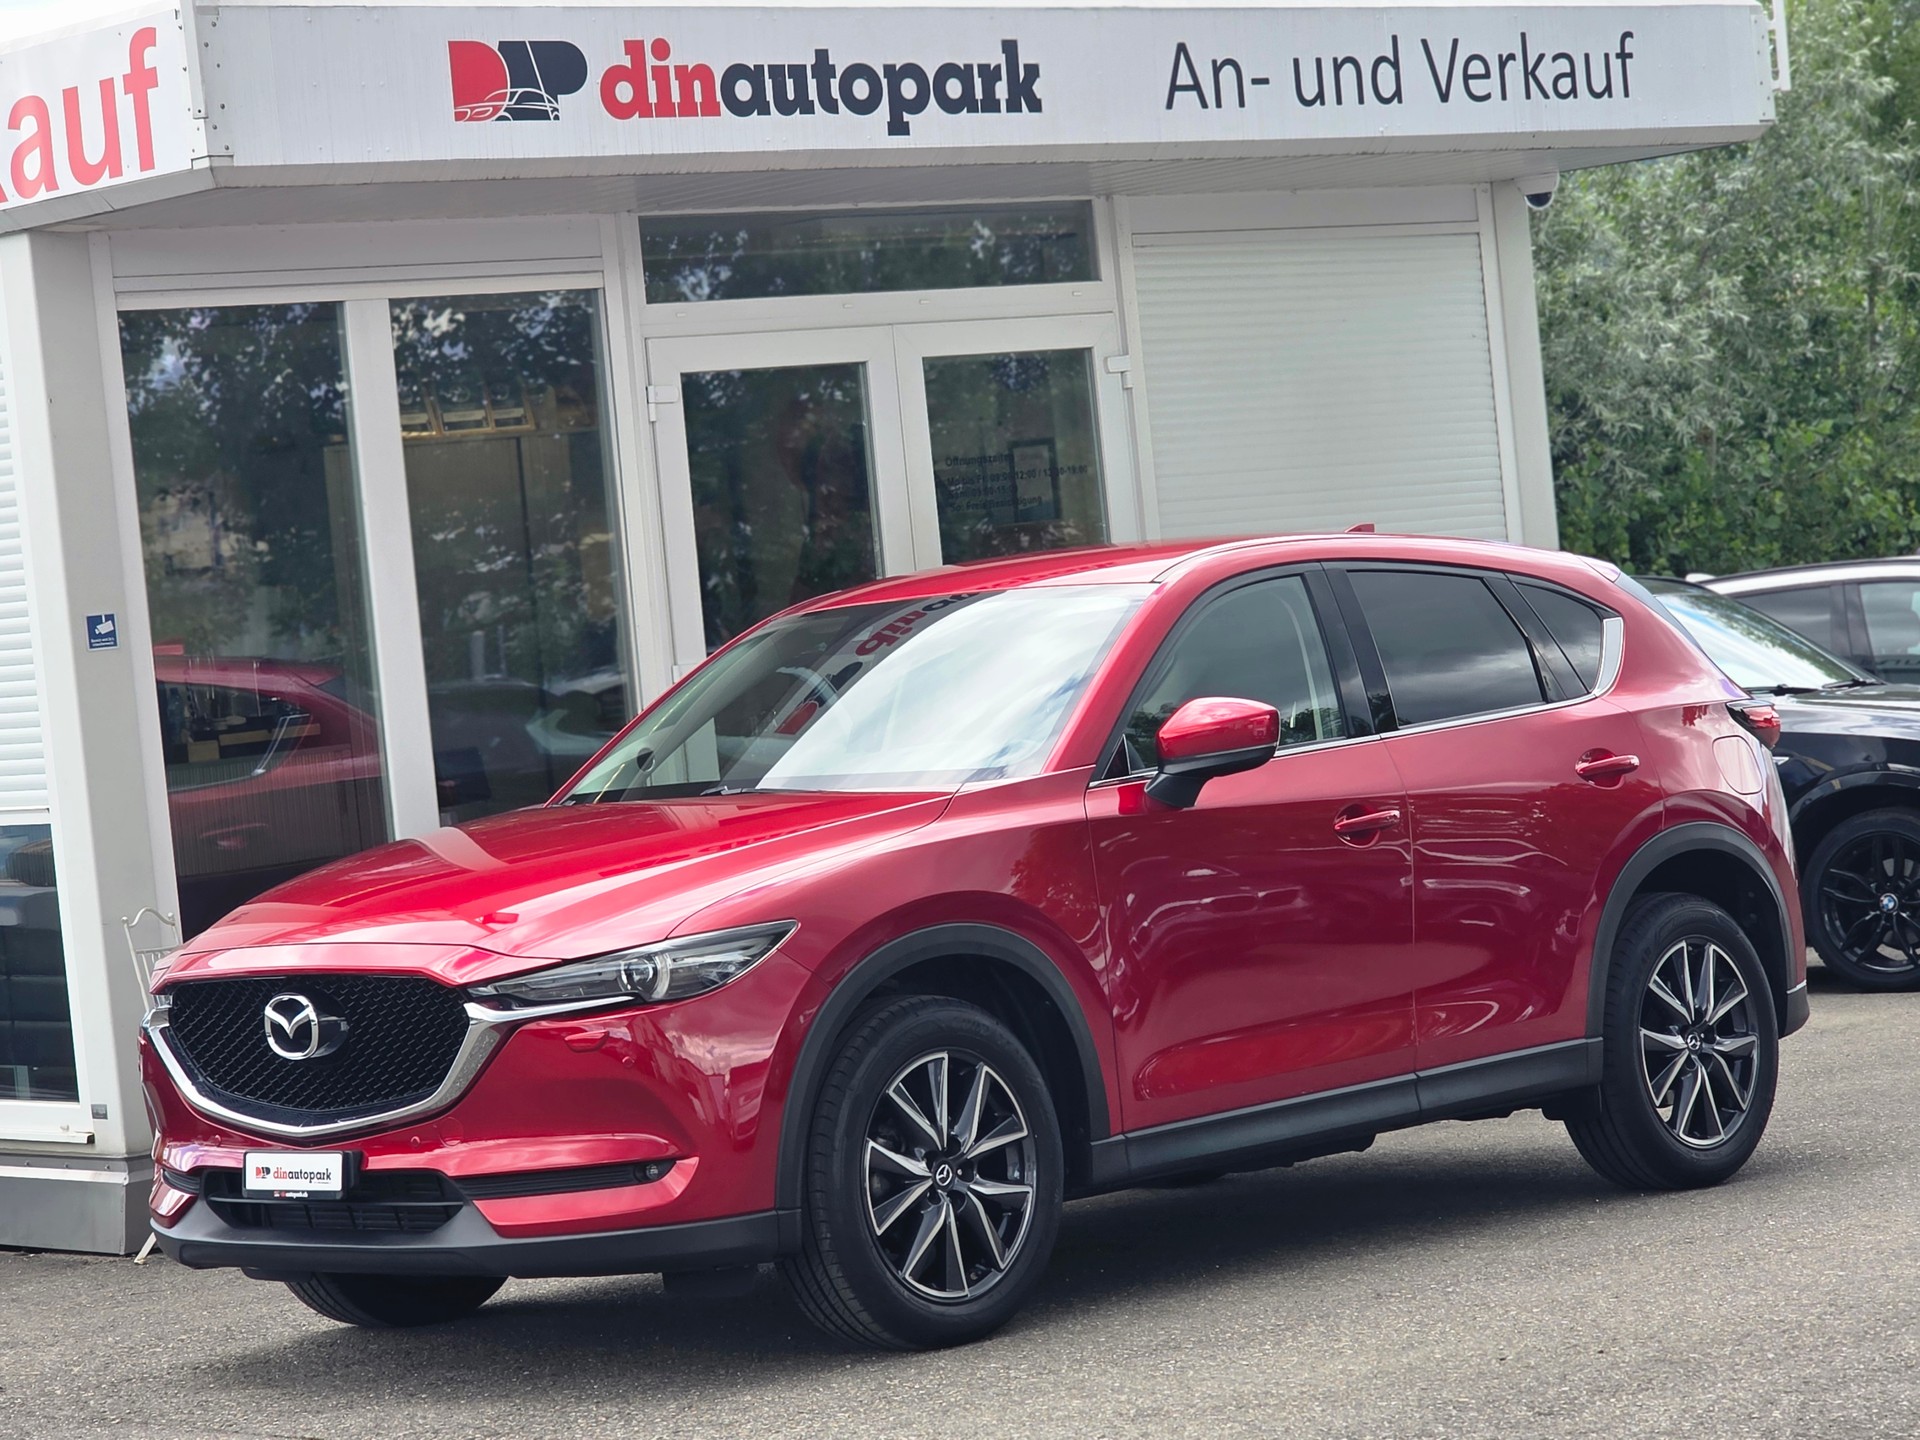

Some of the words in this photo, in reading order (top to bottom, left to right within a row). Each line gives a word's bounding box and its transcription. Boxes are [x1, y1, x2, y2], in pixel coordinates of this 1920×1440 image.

[0, 26, 159, 203] auf
[599, 37, 1043, 136] dinautopark
[1165, 41, 1270, 110] An-
[1292, 34, 1403, 107] und
[1420, 30, 1635, 104] Verkauf
[273, 1167, 331, 1183] dinautopark
